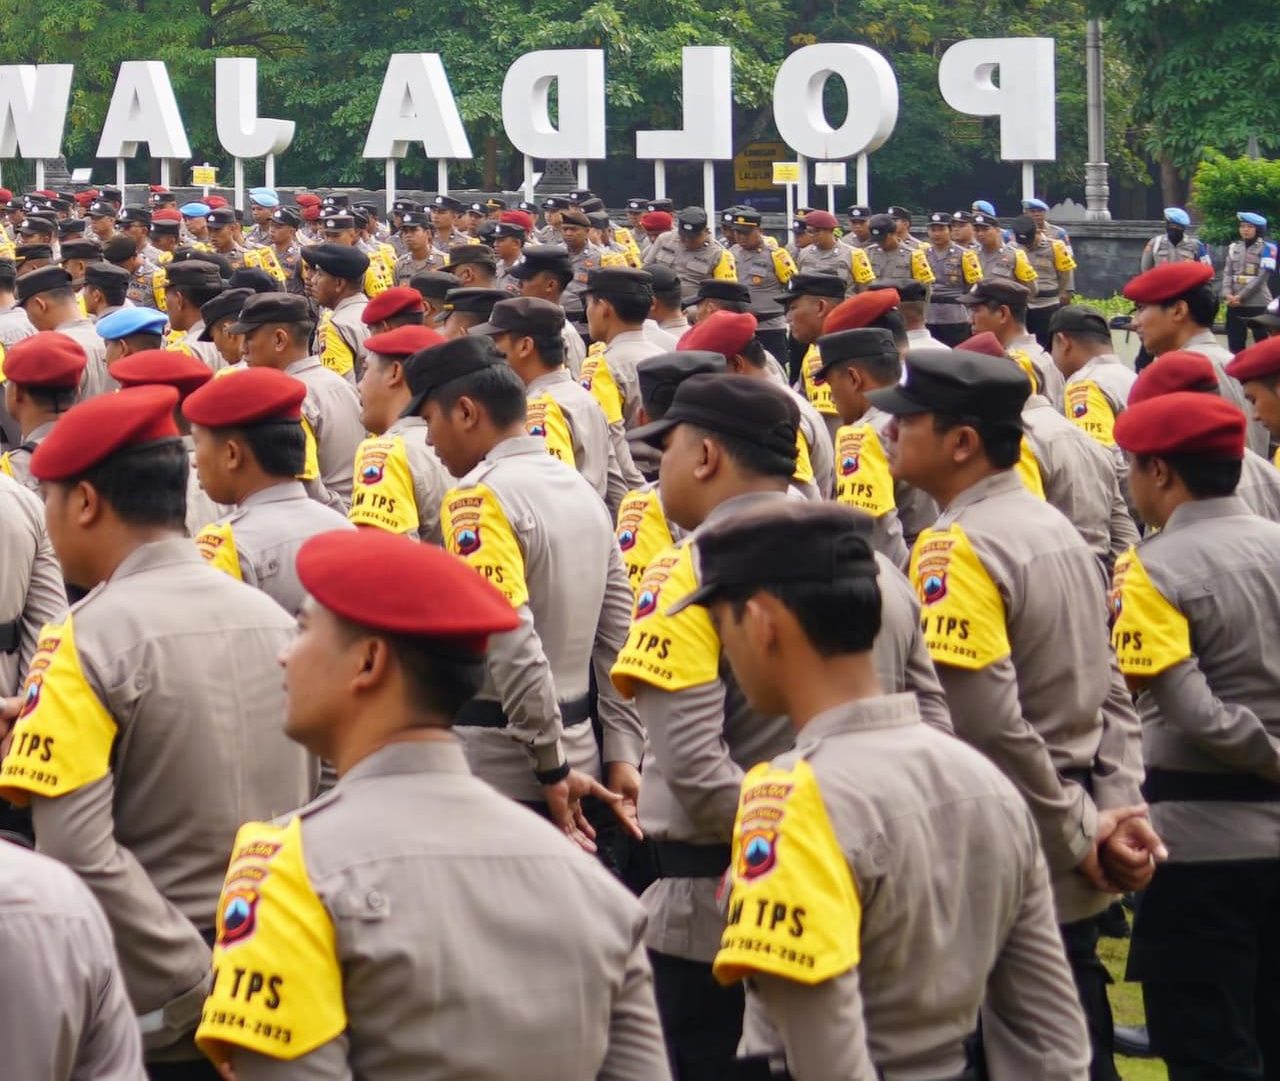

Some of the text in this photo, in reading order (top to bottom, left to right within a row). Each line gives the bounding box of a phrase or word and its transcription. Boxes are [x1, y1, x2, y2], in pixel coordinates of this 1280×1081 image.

[1085, 423, 1102, 433] TPS
[371, 493, 396, 513] TPS
[851, 482, 873, 498] TPS
[936, 615, 970, 641] TPS
[1115, 631, 1142, 651] TPS
[637, 631, 671, 659] TPS
[18, 732, 54, 762] TPS
[756, 898, 807, 938] TPS
[230, 968, 283, 1010] TPS
